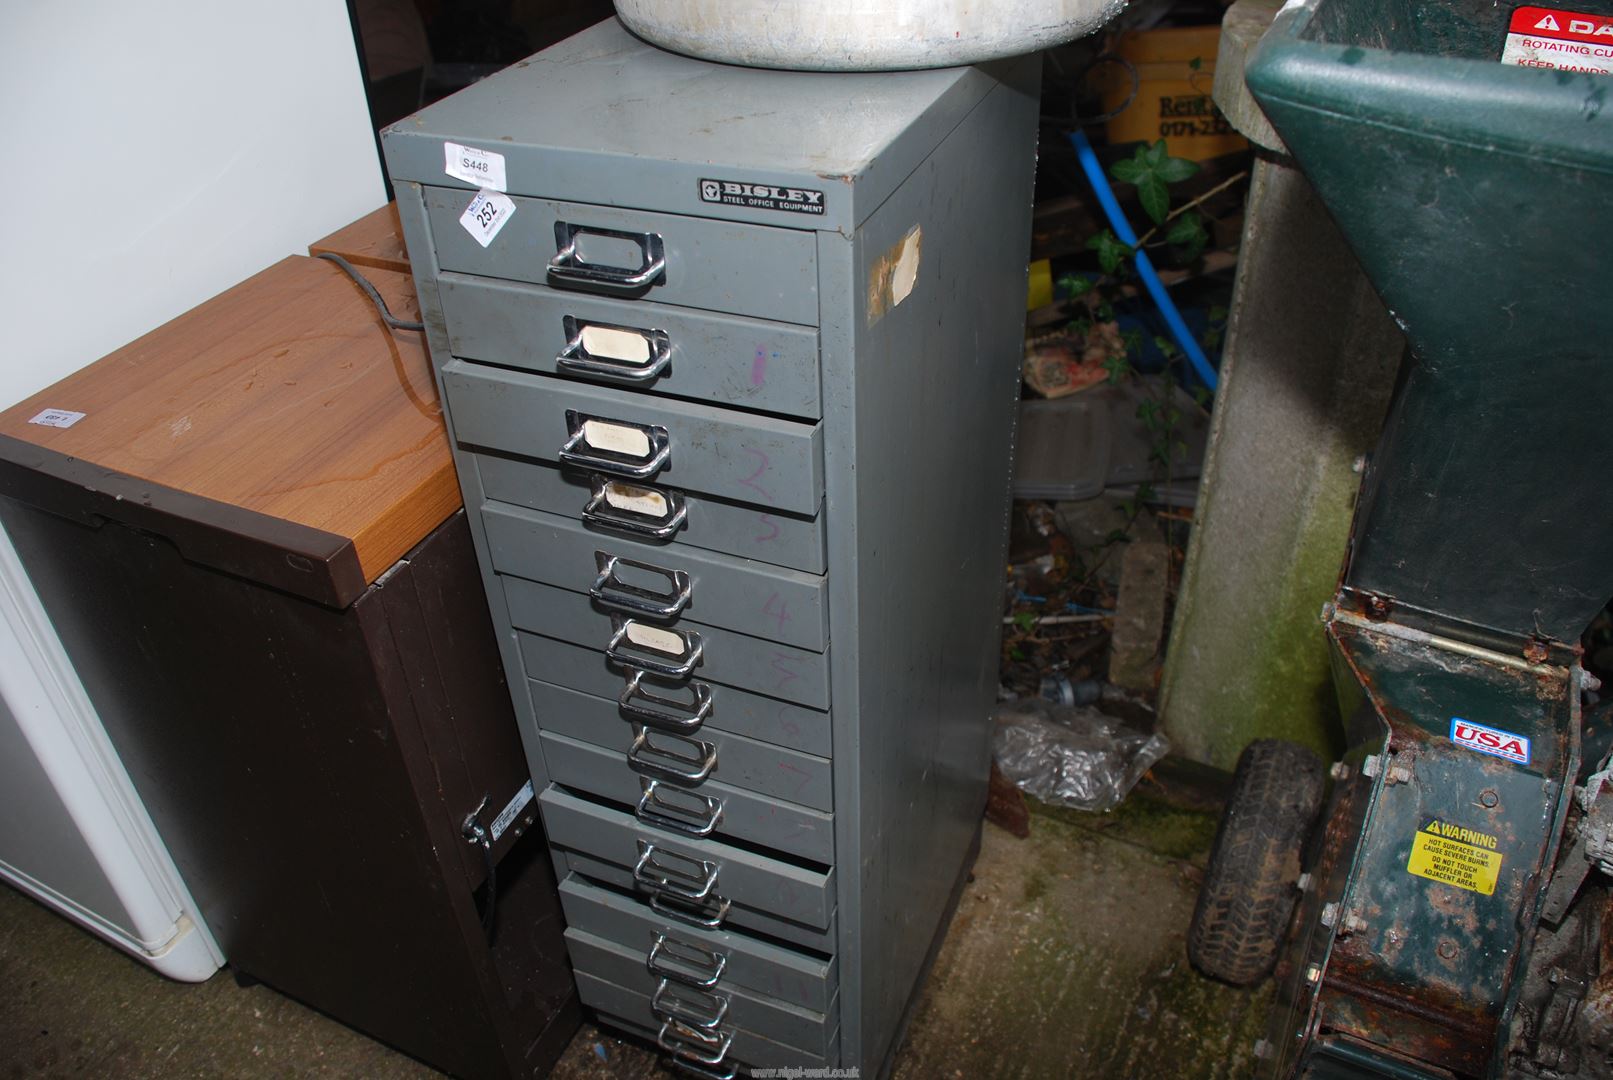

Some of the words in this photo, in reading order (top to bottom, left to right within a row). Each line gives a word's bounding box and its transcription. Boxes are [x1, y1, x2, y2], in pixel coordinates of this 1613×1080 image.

[1522, 39, 1590, 55] ROTATING
[462, 158, 489, 173] S448
[723, 182, 822, 204] BISLEY
[723, 196, 746, 205] STEEL
[748, 198, 775, 208] OFFICE
[779, 201, 823, 213] EQUIPMENT
[476, 201, 498, 229] 252
[1456, 724, 1526, 757] USA
[1441, 823, 1498, 849] WARNING
[1423, 844, 1443, 855] CAUSE
[1444, 849, 1467, 862] SEVERE
[1428, 839, 1441, 848] HOT
[1443, 842, 1474, 857] SURFACES
[1475, 850, 1489, 860] CAN
[1431, 855, 1441, 864] DO
[1442, 858, 1456, 867] NOT
[1456, 862, 1478, 874] TOUCH
[1433, 863, 1462, 877] MUFFLER
[1463, 871, 1473, 880] OR
[1423, 868, 1455, 882] ADJACENT
